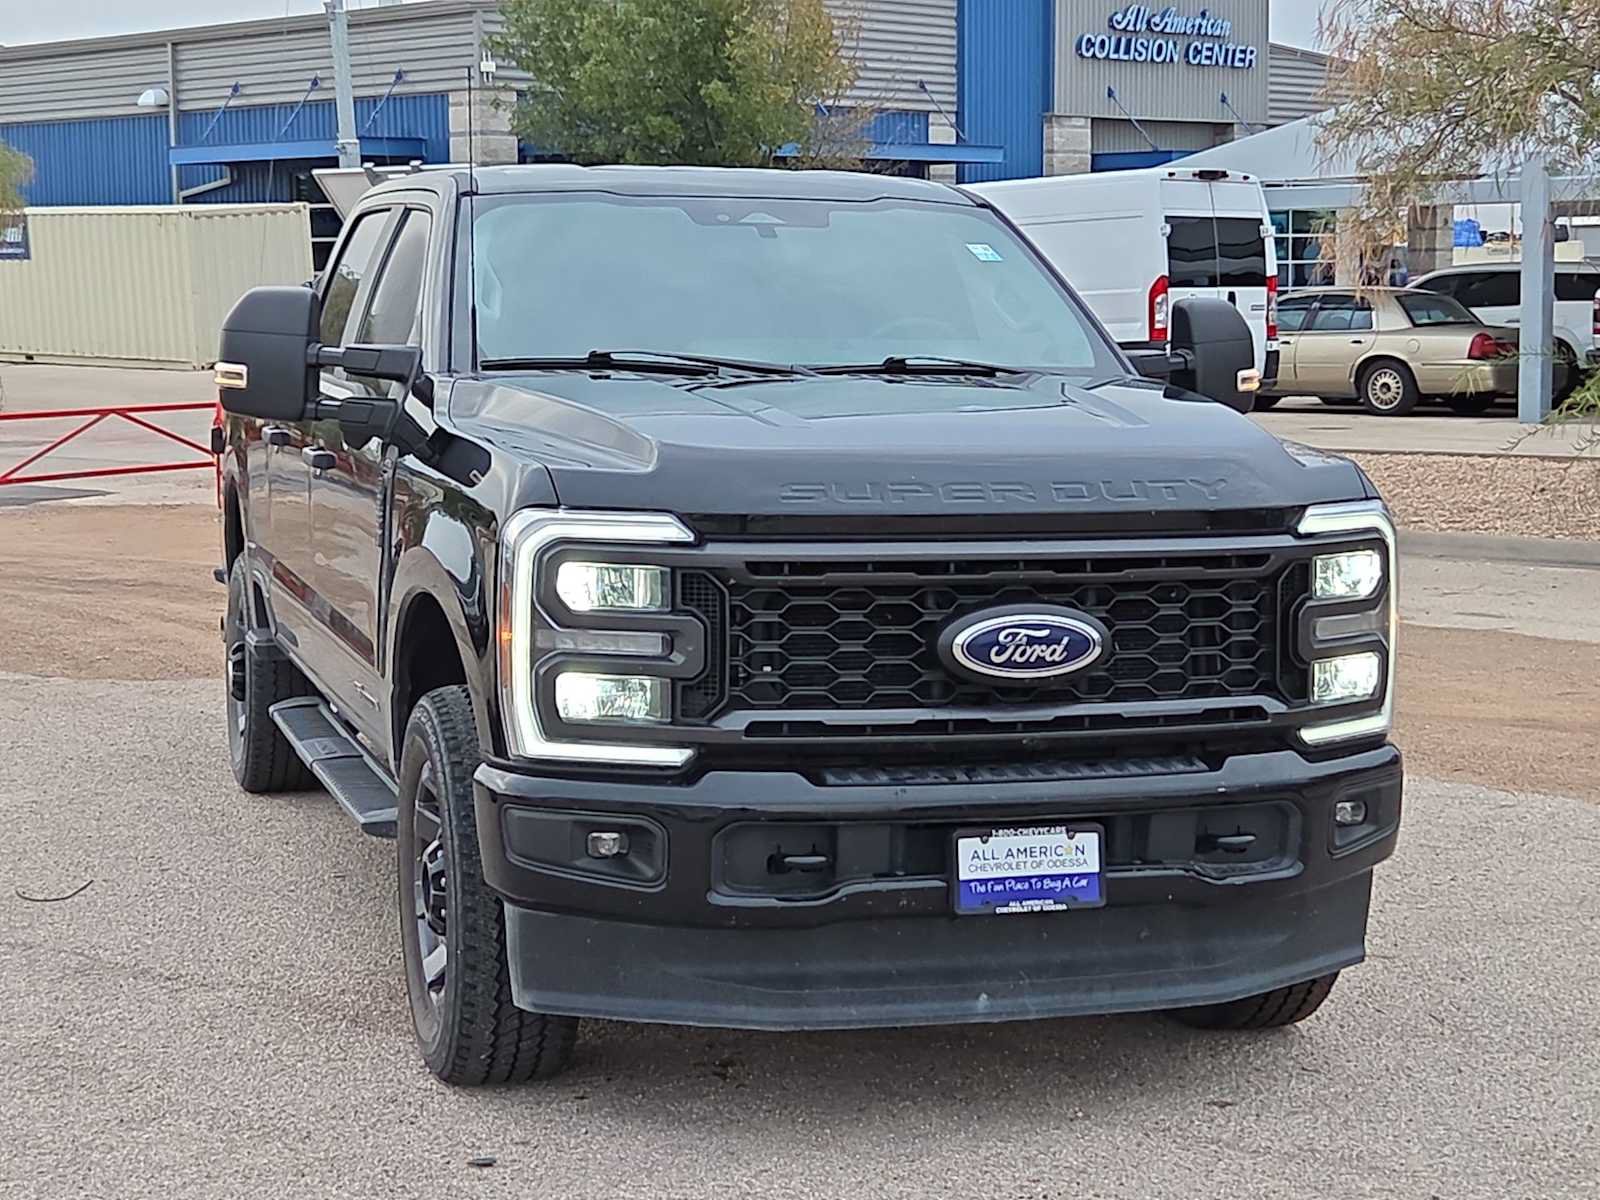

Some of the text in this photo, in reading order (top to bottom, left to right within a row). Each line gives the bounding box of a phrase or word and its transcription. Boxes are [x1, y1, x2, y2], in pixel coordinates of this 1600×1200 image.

[1111, 4, 1232, 37] All American
[1078, 33, 1257, 68] COLLISION CENTER
[779, 478, 1228, 503] SUPER DUTY
[989, 627, 1070, 663] Ford
[968, 859, 1089, 873] CHEVROLET OF ODESSA
[970, 849, 1000, 862] ALL
[1030, 877, 1042, 890] To
[1062, 877, 1071, 889] A
